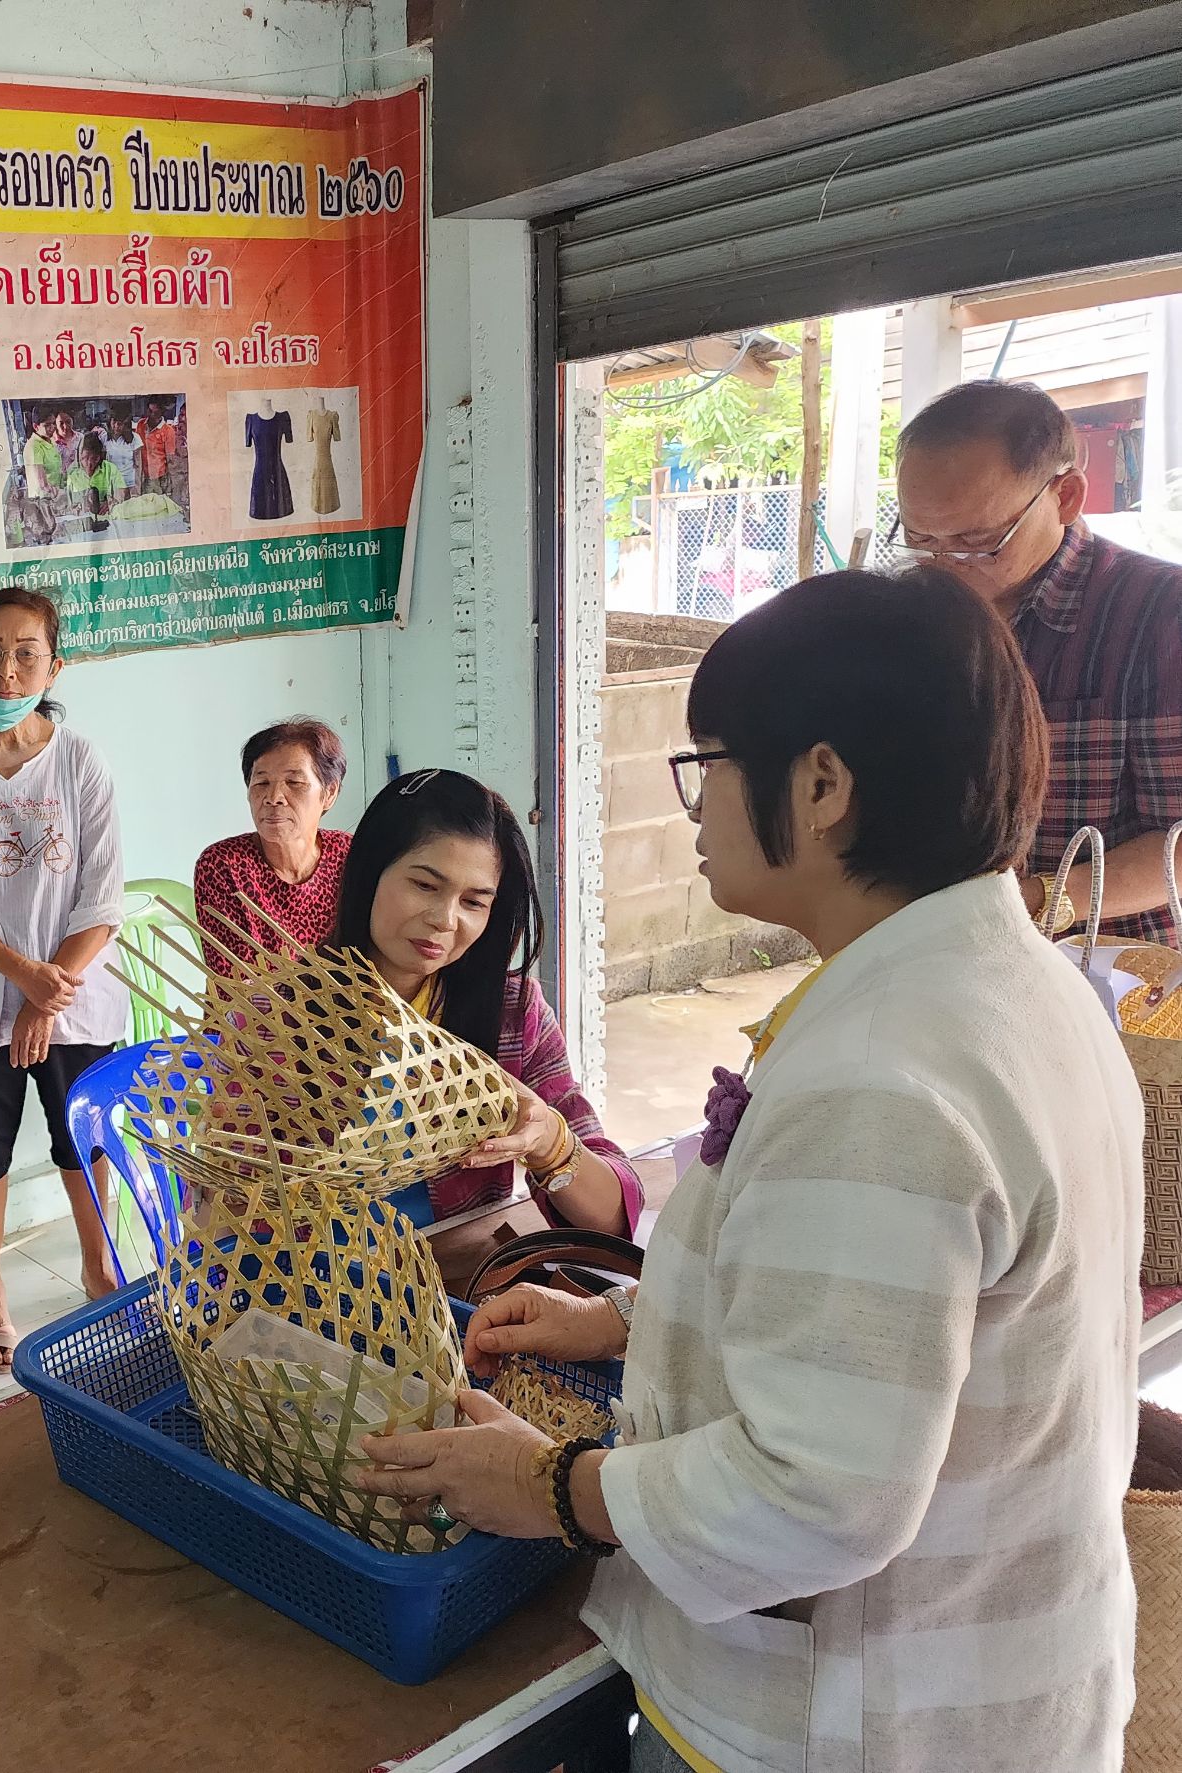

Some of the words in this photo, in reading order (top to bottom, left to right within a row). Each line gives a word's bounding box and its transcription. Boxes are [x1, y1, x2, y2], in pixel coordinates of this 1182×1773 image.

[125, 130, 305, 214] ปีงบประมาณ
[319, 161, 402, 216] ๒๕๖๐
[14, 326, 198, 370] อ.เมืองยโสธร
[215, 323, 320, 367] จ.ยโสธร
